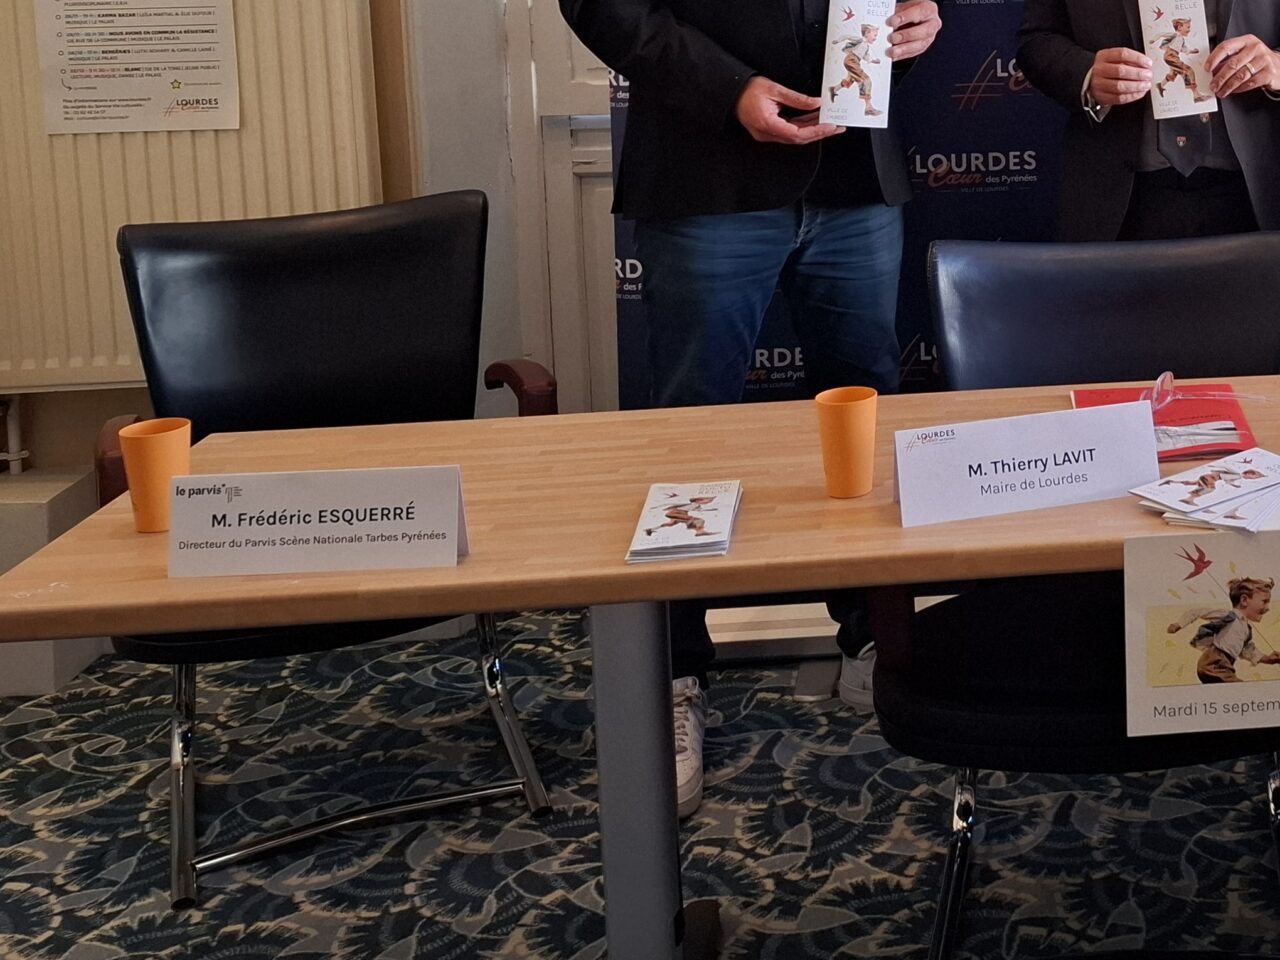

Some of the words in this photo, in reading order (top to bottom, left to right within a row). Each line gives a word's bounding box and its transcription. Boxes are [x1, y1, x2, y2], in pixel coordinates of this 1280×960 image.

[176, 98, 219, 106] LOURDES
[916, 151, 1036, 173] LOURDES
[1001, 175, 1037, 185] Pyrénées
[917, 428, 956, 441] LOURDES
[968, 464, 988, 478] M.
[990, 456, 1049, 474] Thierry
[1053, 448, 1096, 467] LAVIT
[980, 481, 1017, 496] Maire
[1020, 478, 1035, 491] de
[1038, 472, 1089, 488] Lourdes
[211, 513, 232, 528] M.
[238, 509, 312, 527] Frédéric
[318, 501, 416, 524] ESQUERRÉ
[178, 539, 227, 550] Directeur
[228, 538, 242, 548] du
[245, 536, 276, 547] Parvis
[279, 535, 310, 546] Scène
[313, 534, 363, 545] Nationale
[365, 532, 398, 543] Tarbes
[401, 530, 447, 543] Pyrénées
[1152, 702, 1198, 719] Mardi
[1202, 702, 1218, 715] 15
